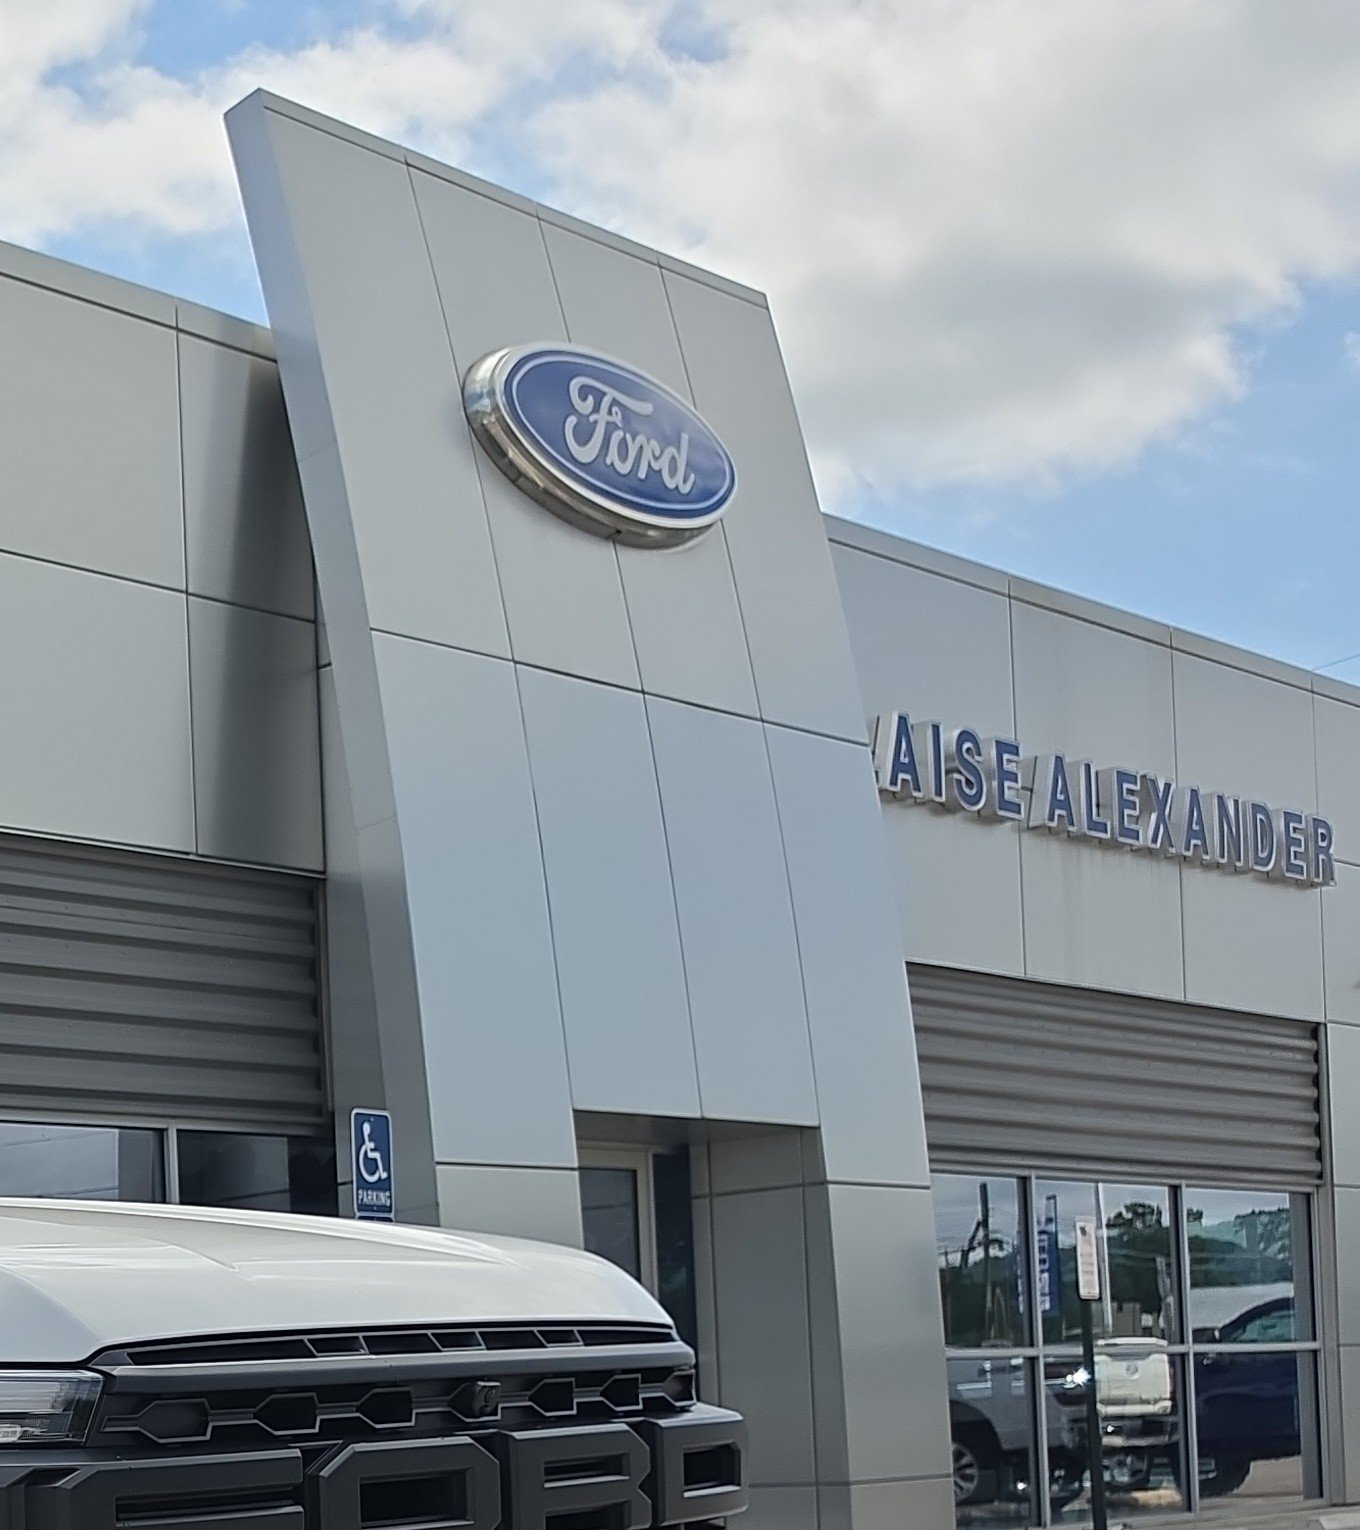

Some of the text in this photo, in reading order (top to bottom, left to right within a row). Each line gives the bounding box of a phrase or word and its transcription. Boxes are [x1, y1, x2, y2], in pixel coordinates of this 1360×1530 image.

[564, 376, 695, 495] Ford
[1042, 751, 1337, 887] ALEXANDER
[357, 1189, 391, 1207] PARKING
